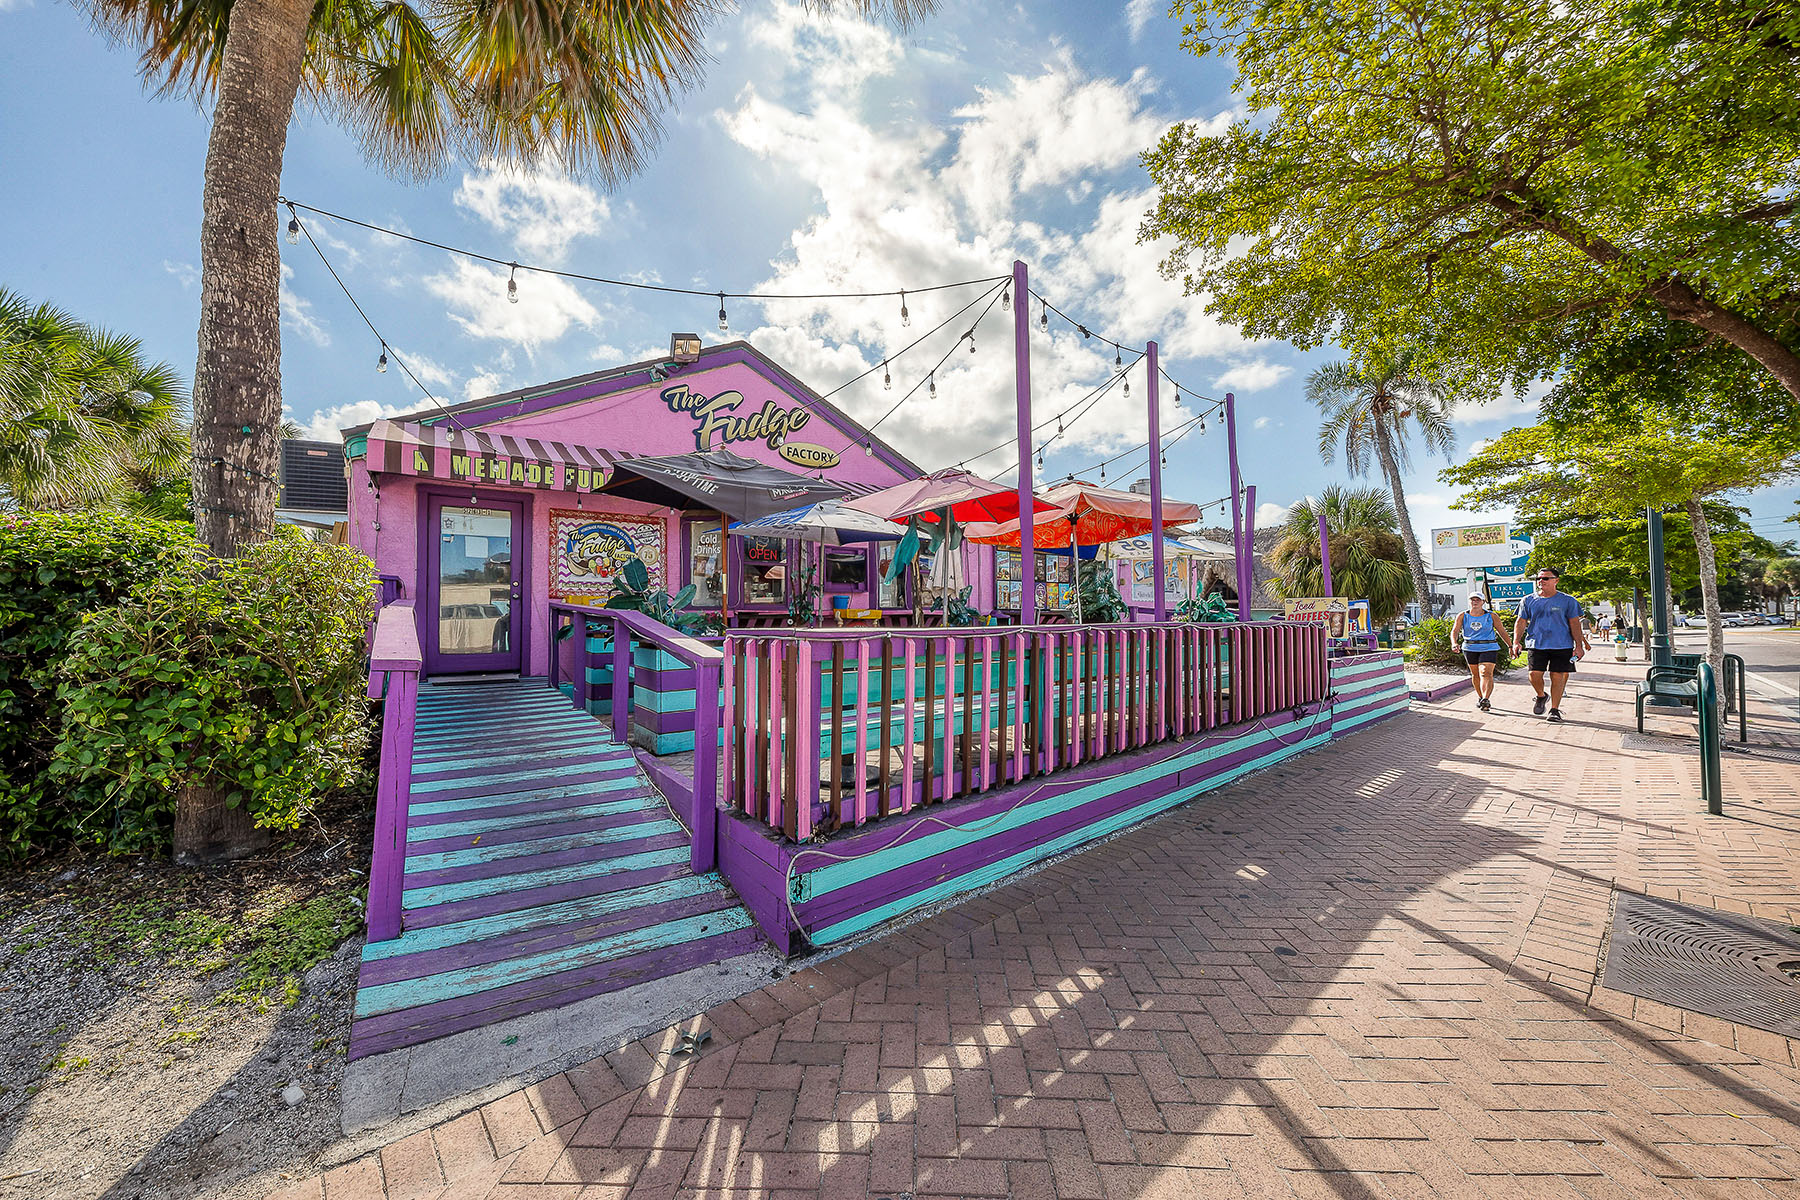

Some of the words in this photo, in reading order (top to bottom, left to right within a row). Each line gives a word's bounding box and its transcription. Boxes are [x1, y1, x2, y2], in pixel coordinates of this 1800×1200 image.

[662, 385, 707, 412] The
[692, 390, 810, 452] Fudge
[786, 446, 834, 464] FACTORY
[414, 450, 554, 486] HMEMADE
[565, 468, 614, 490] FUD
[692, 478, 719, 495] TIME
[568, 530, 585, 540] The
[700, 534, 718, 544] Cold
[579, 532, 627, 558] Fudge
[697, 545, 721, 554] Drinks
[614, 552, 636, 560] FACTORY
[749, 548, 778, 560] OPEN
[1293, 600, 1316, 613] Iced
[1287, 610, 1330, 621] COFFEES
